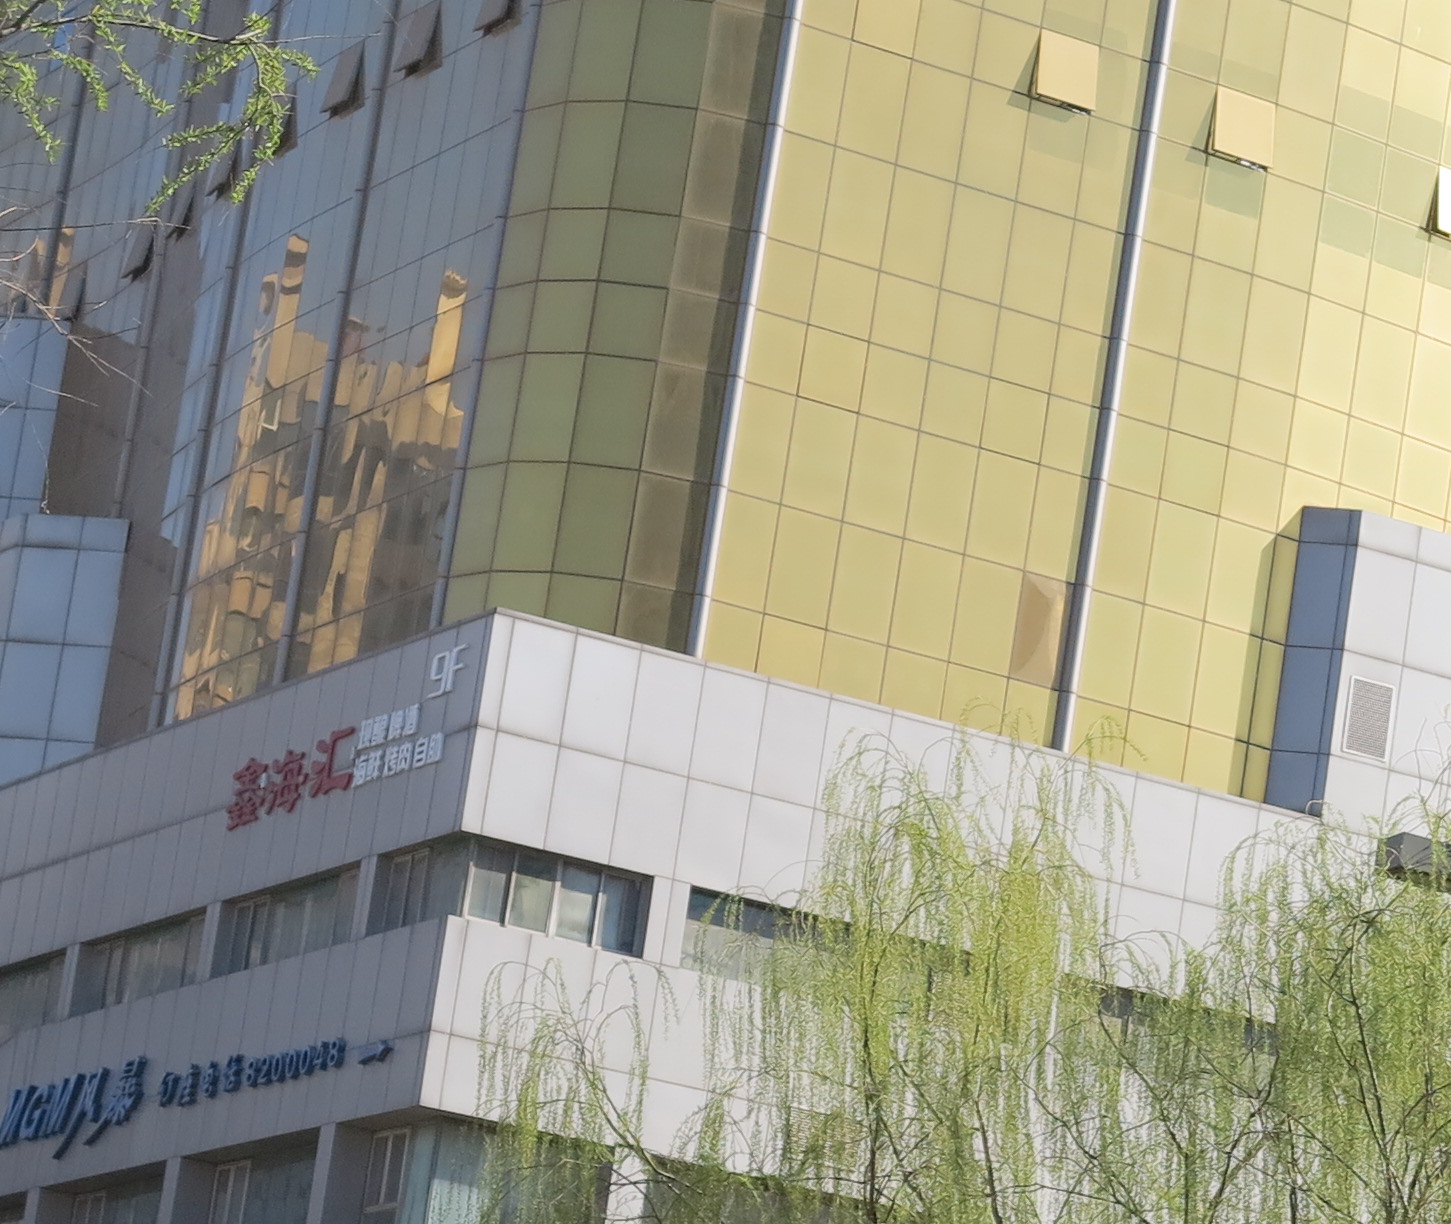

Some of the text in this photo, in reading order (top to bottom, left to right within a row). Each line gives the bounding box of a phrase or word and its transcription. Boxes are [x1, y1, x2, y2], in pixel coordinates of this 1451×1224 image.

[226, 726, 356, 831] 鑫海汇
[352, 732, 444, 788] 海鲜烤肉自助
